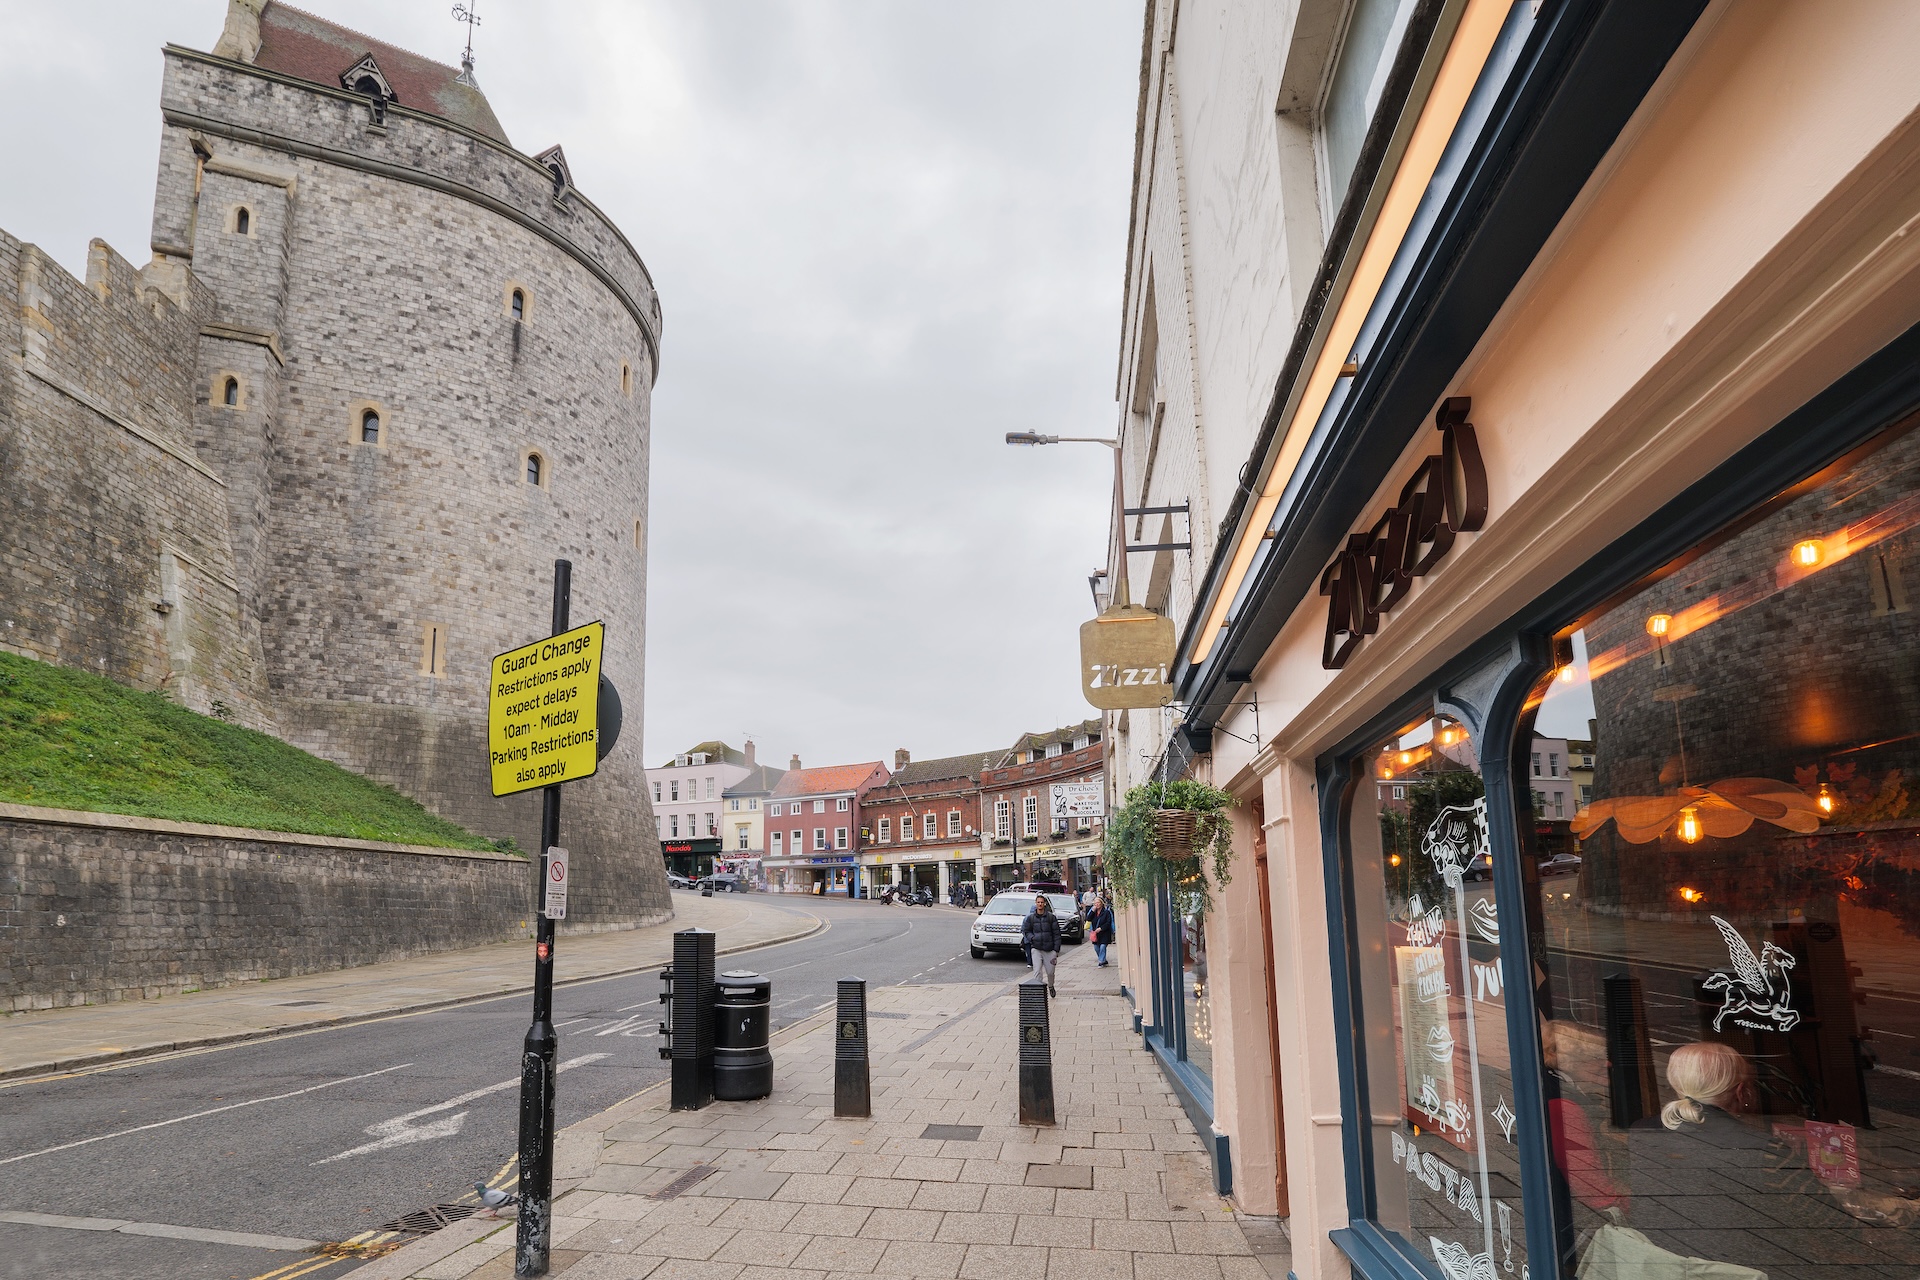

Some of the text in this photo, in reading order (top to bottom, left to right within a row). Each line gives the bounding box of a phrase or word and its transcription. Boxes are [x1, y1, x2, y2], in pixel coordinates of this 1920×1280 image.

[501, 634, 590, 675] Guard Change
[497, 657, 592, 697] Restrictions apply
[1090, 662, 1169, 689] Zizzi
[506, 685, 577, 716] expect delays
[503, 721, 531, 740] 10am
[540, 708, 580, 731] Midday
[492, 728, 595, 766] Parking Restrictions
[516, 758, 567, 783] also apply
[665, 844, 692, 853] Nando's
[1409, 909, 1443, 951] FEELING
[1415, 943, 1443, 975] RATHER
[1418, 971, 1446, 997] PECKISH
[1734, 1019, 1774, 1031] Toscana
[1839, 1133, 1856, 1154] SIP
[1845, 1154, 1857, 1165] IT
[1391, 1130, 1483, 1224] PASTA
